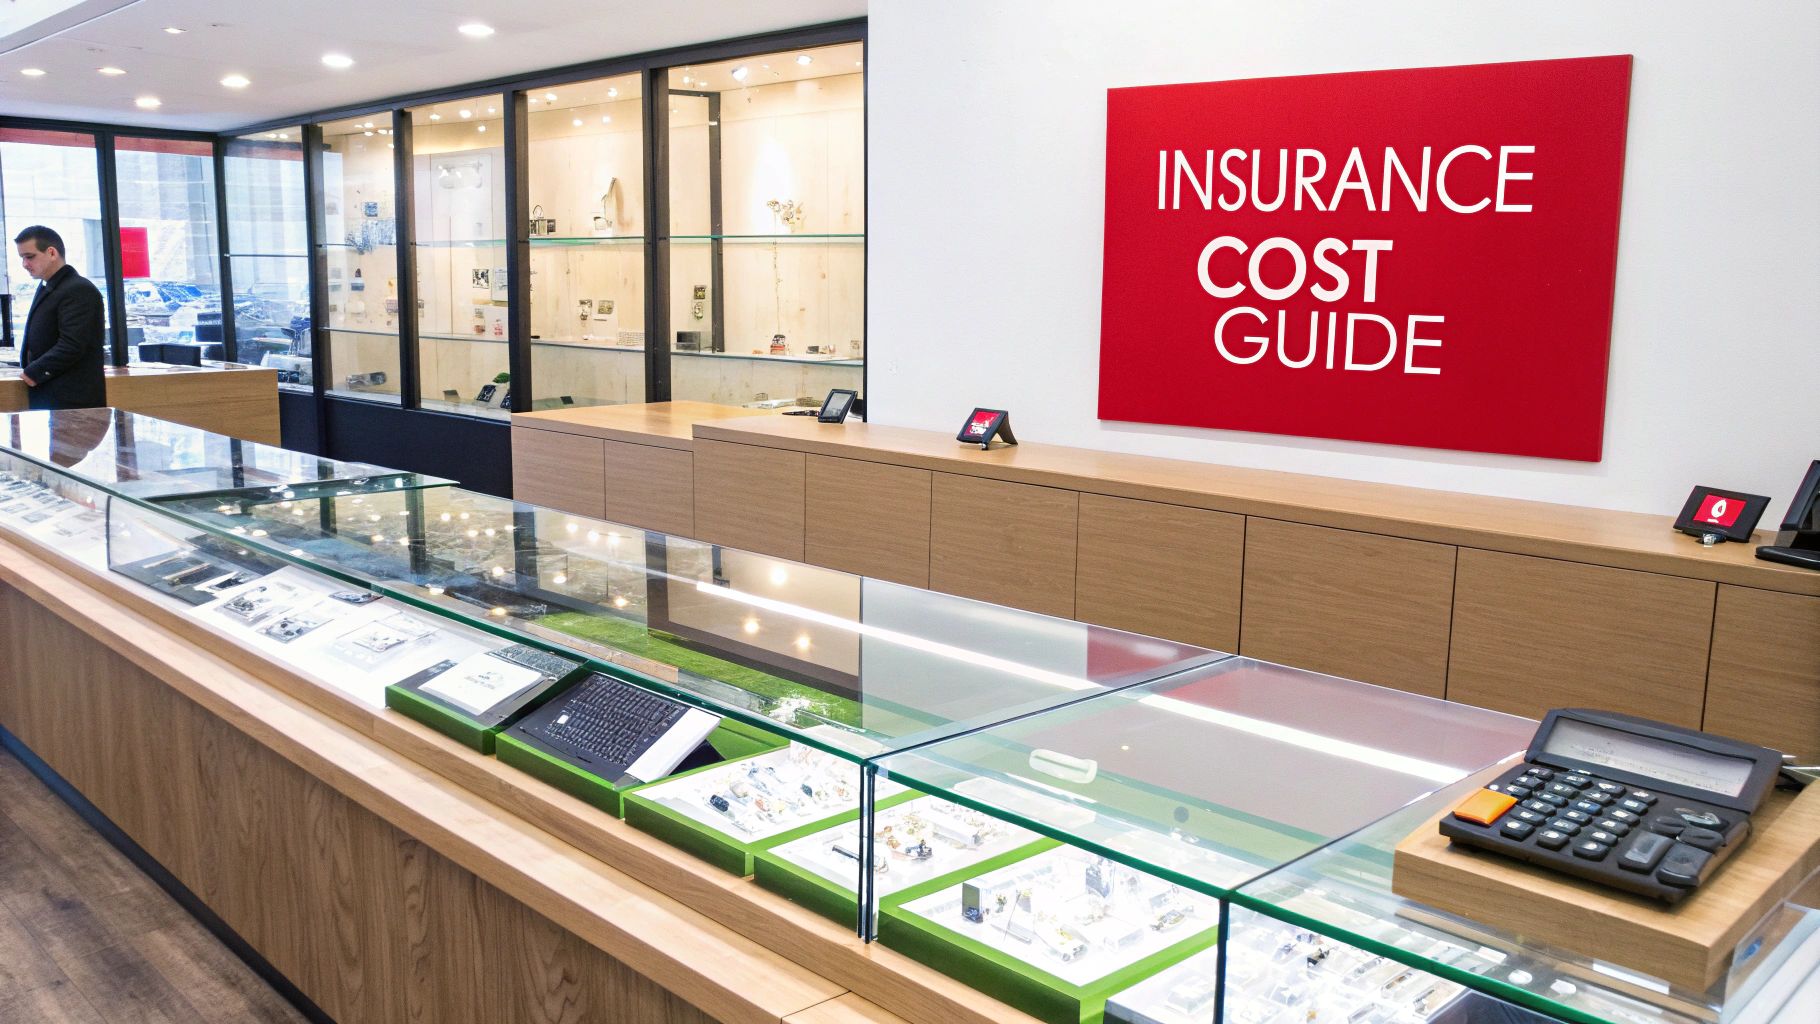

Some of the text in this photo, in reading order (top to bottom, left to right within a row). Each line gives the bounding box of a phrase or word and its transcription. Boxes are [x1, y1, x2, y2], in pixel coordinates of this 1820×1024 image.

[1157, 145, 1536, 213] INSURANCE
[1197, 235, 1394, 303] COST
[1214, 306, 1445, 375] GUIDE
